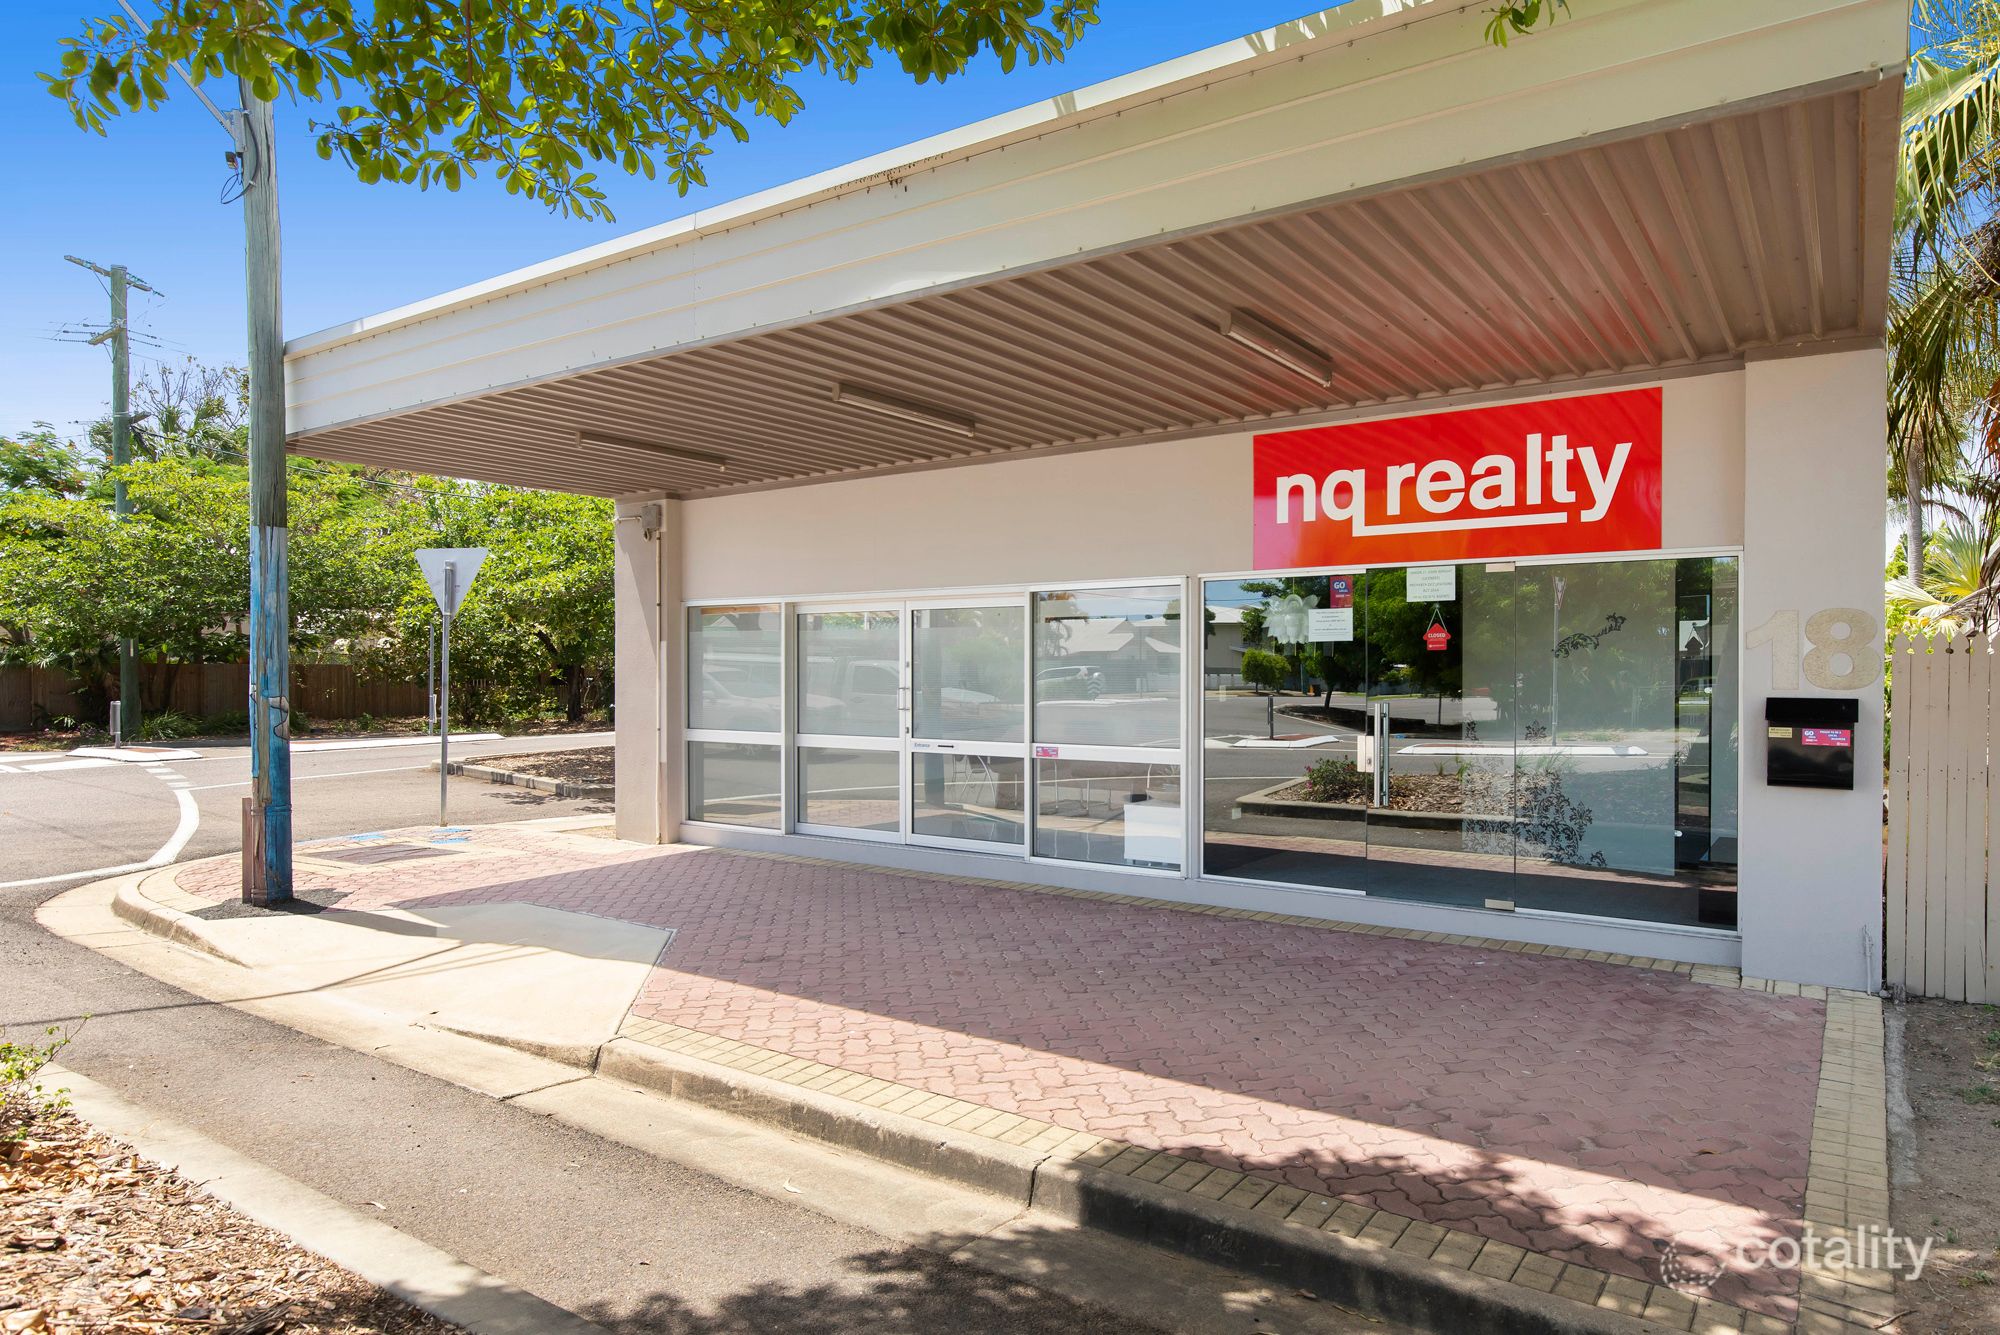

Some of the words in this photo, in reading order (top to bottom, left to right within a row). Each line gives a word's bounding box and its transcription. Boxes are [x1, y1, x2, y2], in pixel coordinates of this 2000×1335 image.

[1276, 468, 1367, 537] nq
[1387, 433, 1633, 522] realty
[1333, 581, 1346, 589] GO
[1745, 607, 1882, 690] 18
